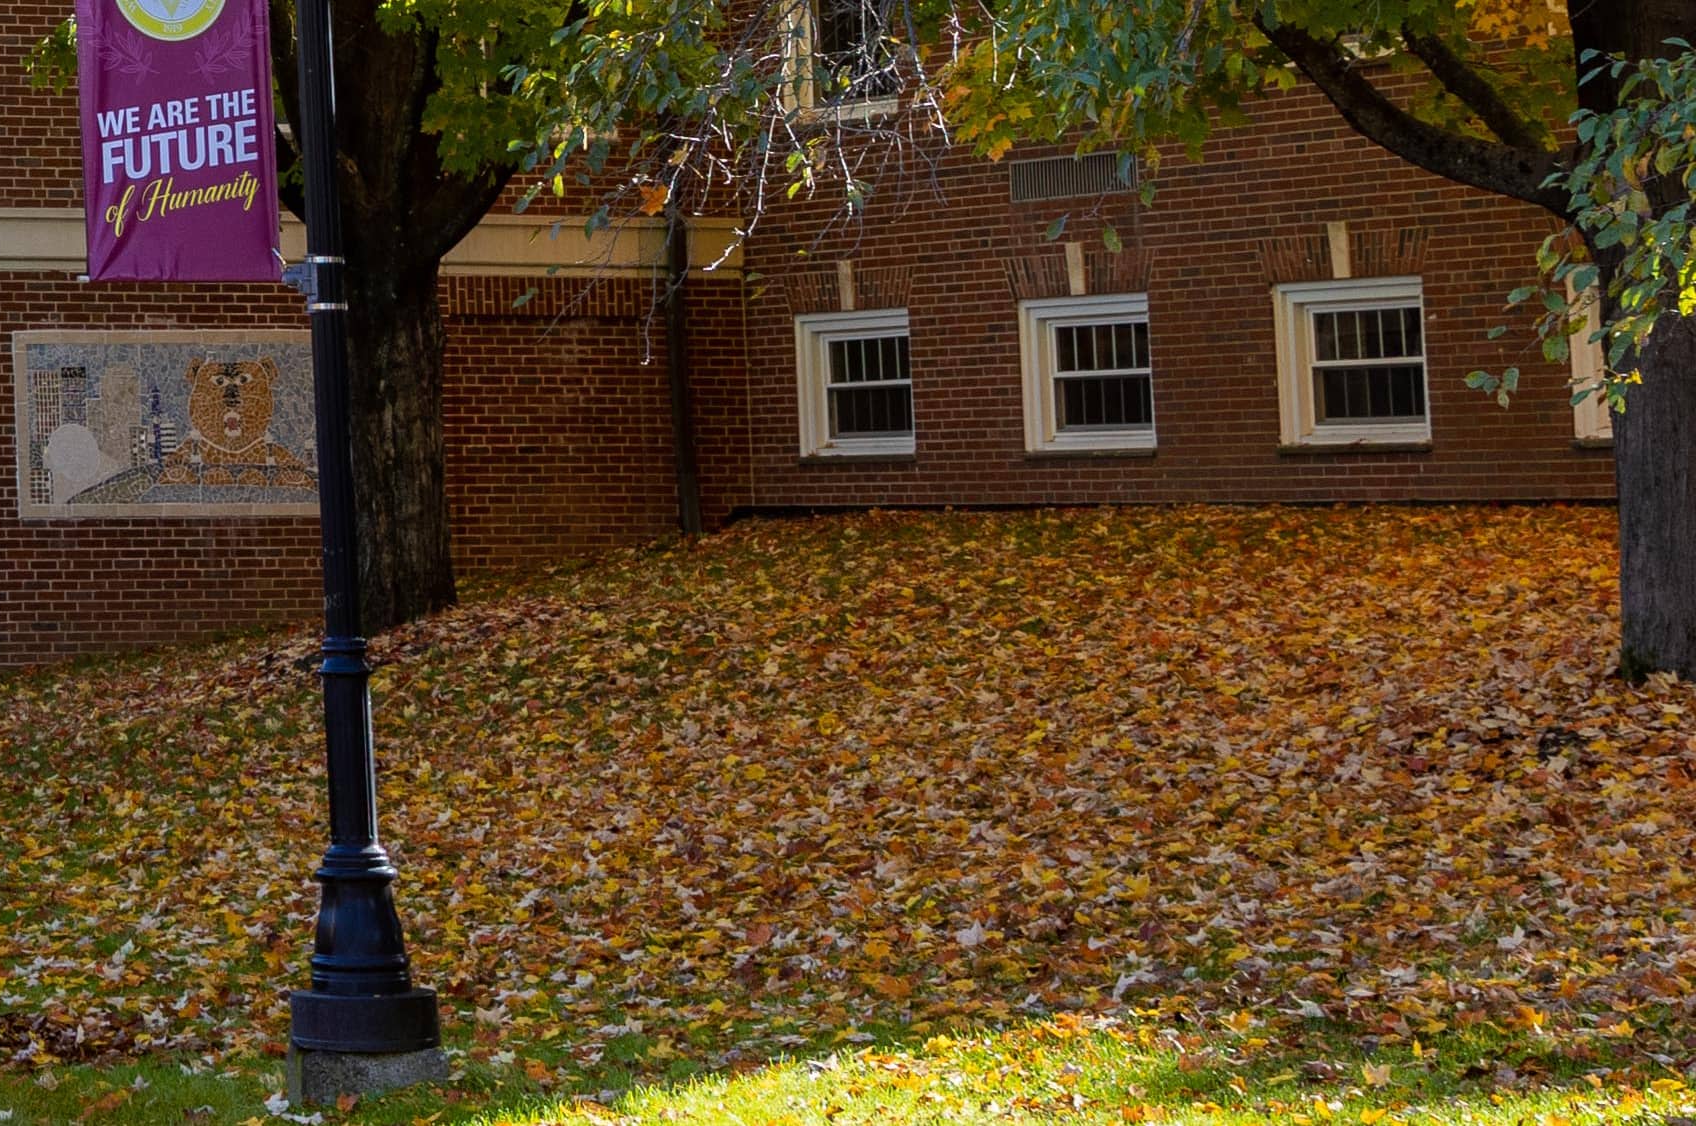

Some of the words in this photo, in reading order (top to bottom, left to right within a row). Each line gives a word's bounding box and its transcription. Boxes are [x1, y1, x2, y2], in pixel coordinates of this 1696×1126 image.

[97, 106, 140, 138] WE
[148, 98, 199, 130] ARE
[205, 88, 256, 120] THE
[102, 119, 259, 184] FUTURE
[105, 184, 136, 238] of
[136, 170, 260, 222] Humanity
